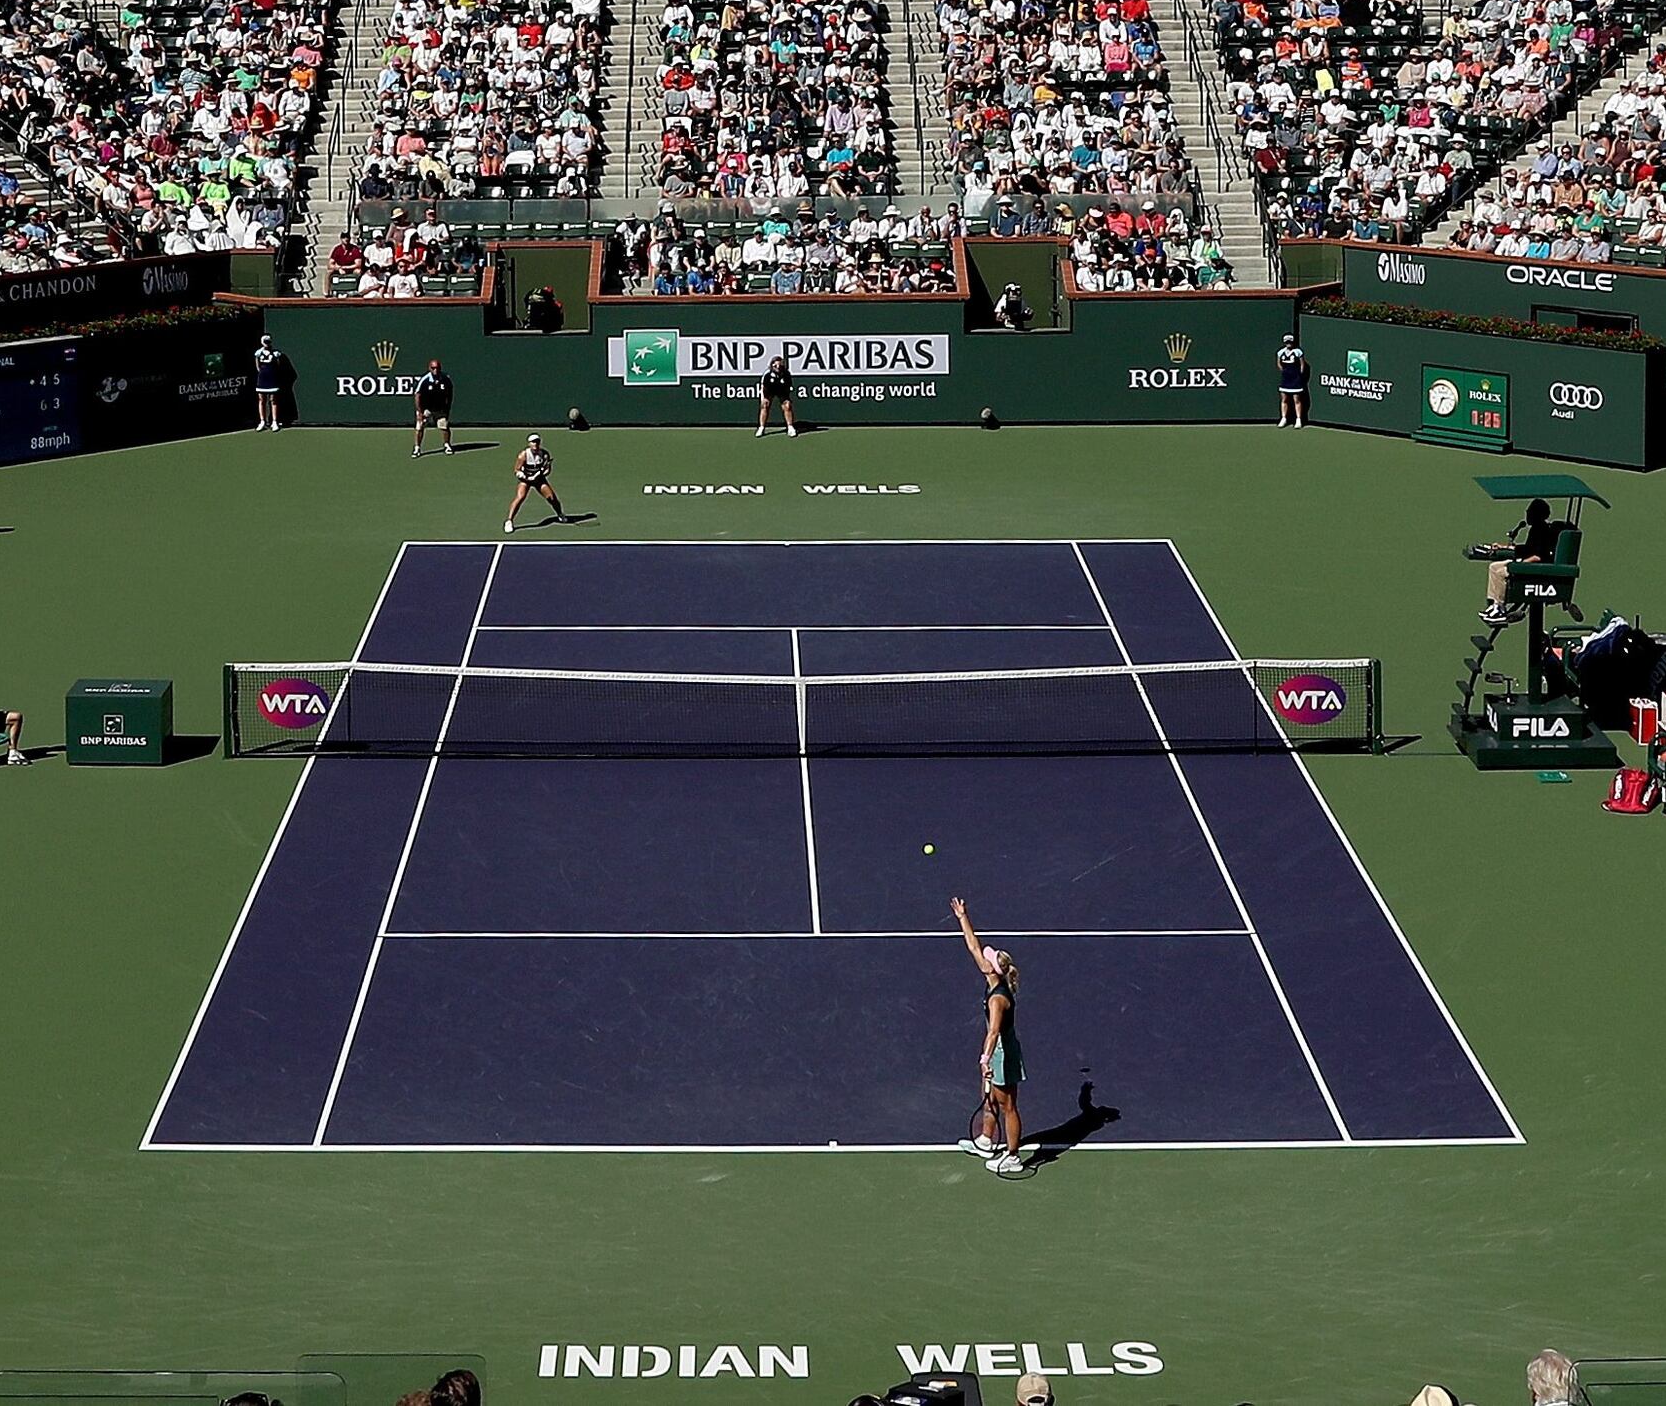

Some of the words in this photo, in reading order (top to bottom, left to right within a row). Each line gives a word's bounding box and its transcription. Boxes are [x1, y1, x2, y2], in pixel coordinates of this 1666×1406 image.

[9, 274, 97, 301] CHANDON
[1506, 265, 1614, 292] ORACLE
[691, 342, 765, 372] BNP
[782, 339, 935, 370] PARIBAS
[39, 375, 47, 387] 4
[53, 373, 60, 385] 5
[179, 381, 208, 395] BANK
[218, 376, 248, 390] WEST
[1129, 368, 1227, 389] ROLEX
[1320, 375, 1351, 389] BANK
[1360, 380, 1393, 393] WEST
[692, 382, 724, 398] The
[728, 382, 763, 398] bank
[798, 386, 808, 398] a
[812, 383, 885, 401] changing
[889, 382, 936, 397] world
[1348, 389, 1383, 401] PARIBAS
[1469, 390, 1502, 403] ROLEX
[40, 399, 48, 411] 6
[53, 398, 60, 409] 3
[1551, 408, 1575, 420] Audi
[30, 432, 70, 450] 88mph
[642, 484, 765, 494] INDIAN
[802, 484, 922, 494] WELLS
[1524, 584, 1557, 596] FILA
[260, 692, 327, 715] WTA
[1278, 690, 1343, 712] WTA
[1512, 717, 1570, 737] FILA
[80, 735, 102, 746] BNP
[103, 735, 147, 746] PARIBAS
[538, 1344, 810, 1378] INDIAN
[895, 1341, 1165, 1376] WELLS
